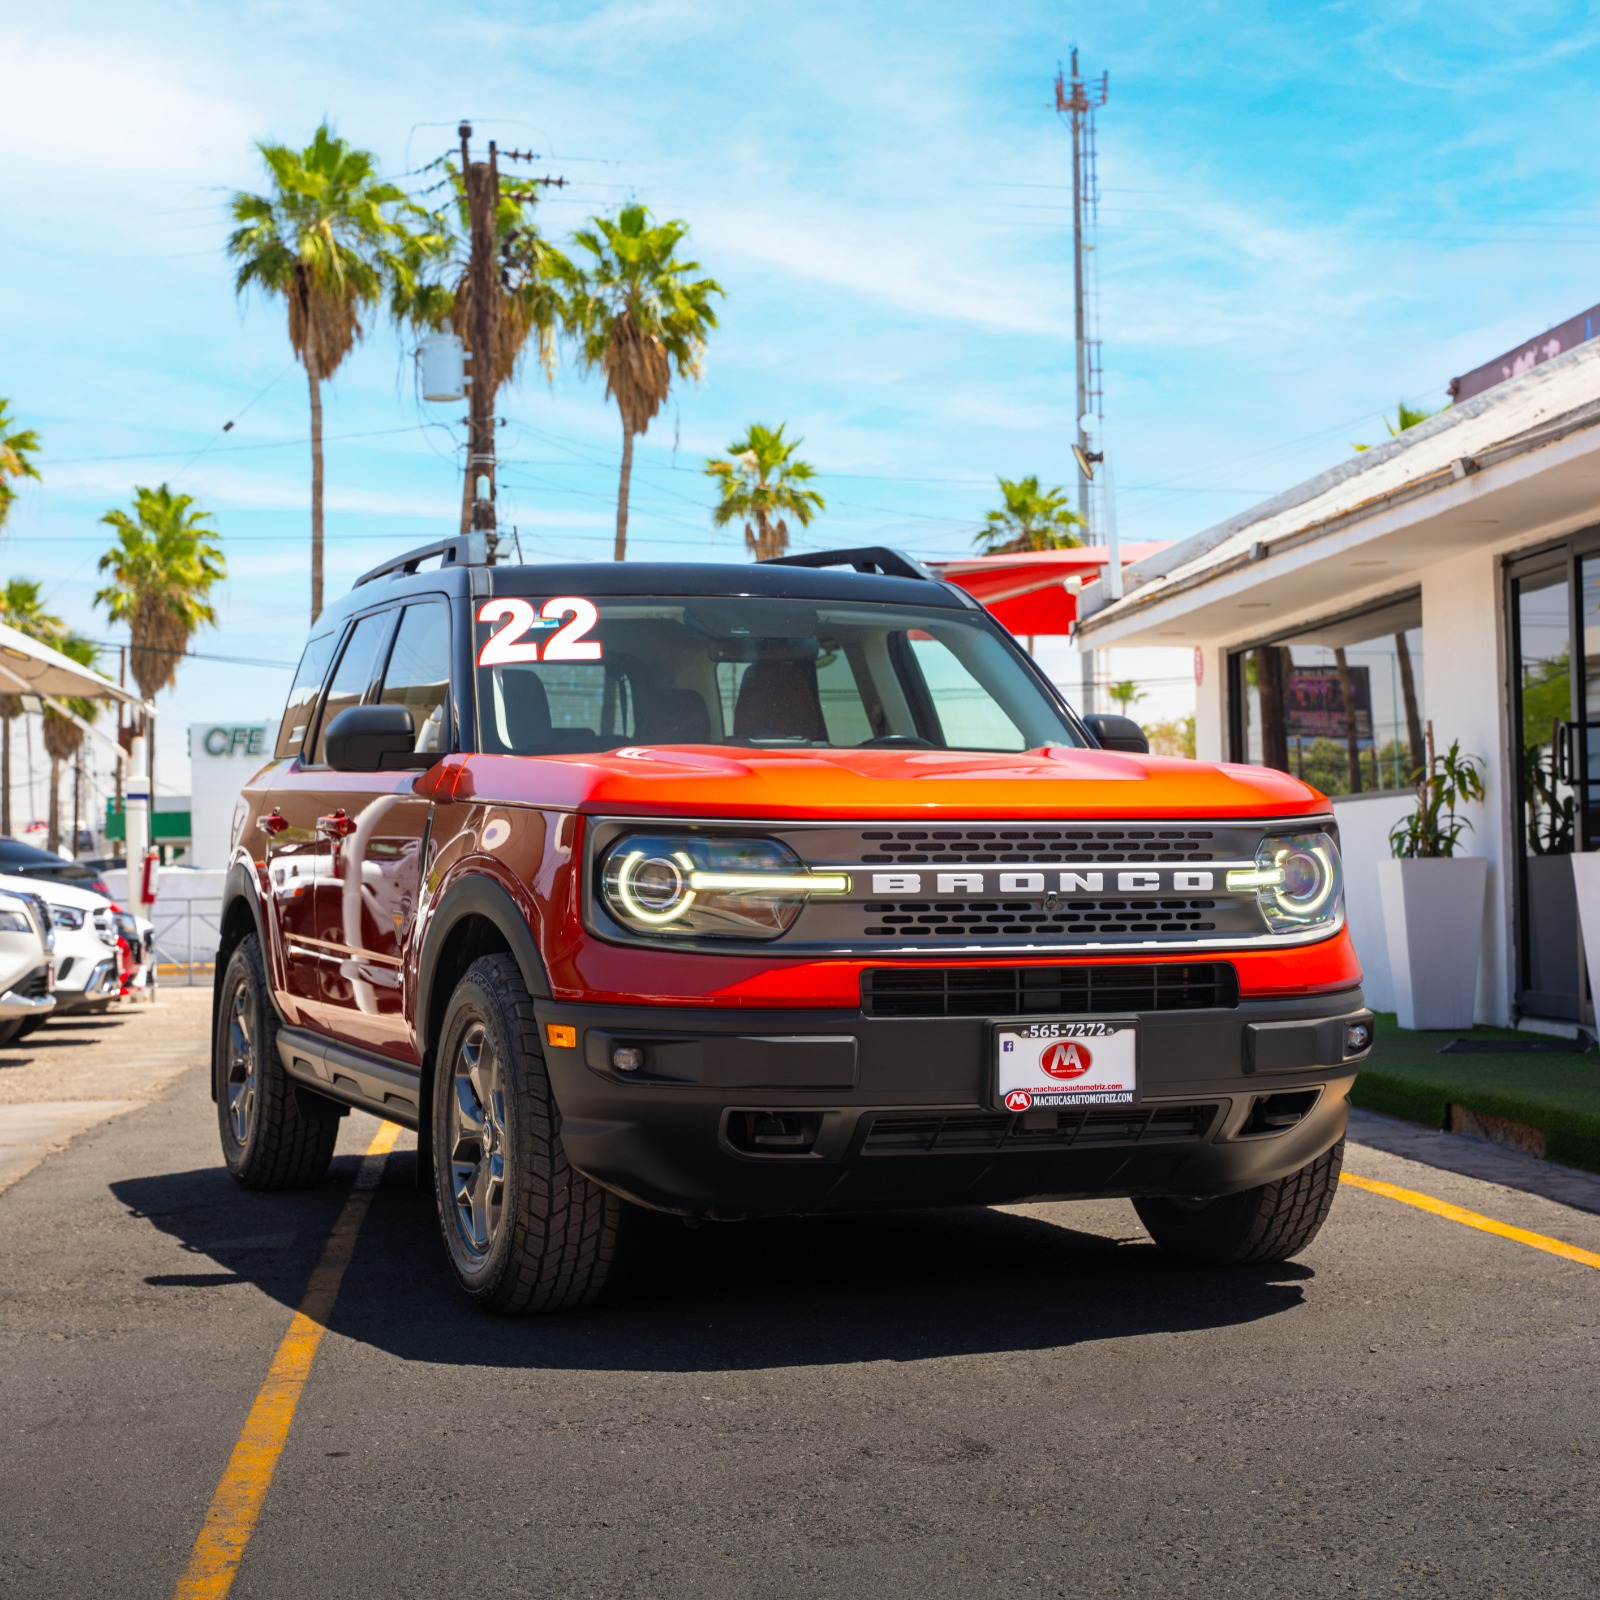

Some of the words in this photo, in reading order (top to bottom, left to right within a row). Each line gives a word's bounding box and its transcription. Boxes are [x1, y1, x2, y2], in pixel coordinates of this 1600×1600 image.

[476, 596, 603, 667] 22
[204, 727, 266, 756] CFE
[872, 872, 1214, 893] BRONCO
[1030, 1023, 1105, 1037] 565-7272
[1033, 1093, 1133, 1106] MACHUCASAUTOMOTRIZ.COM
